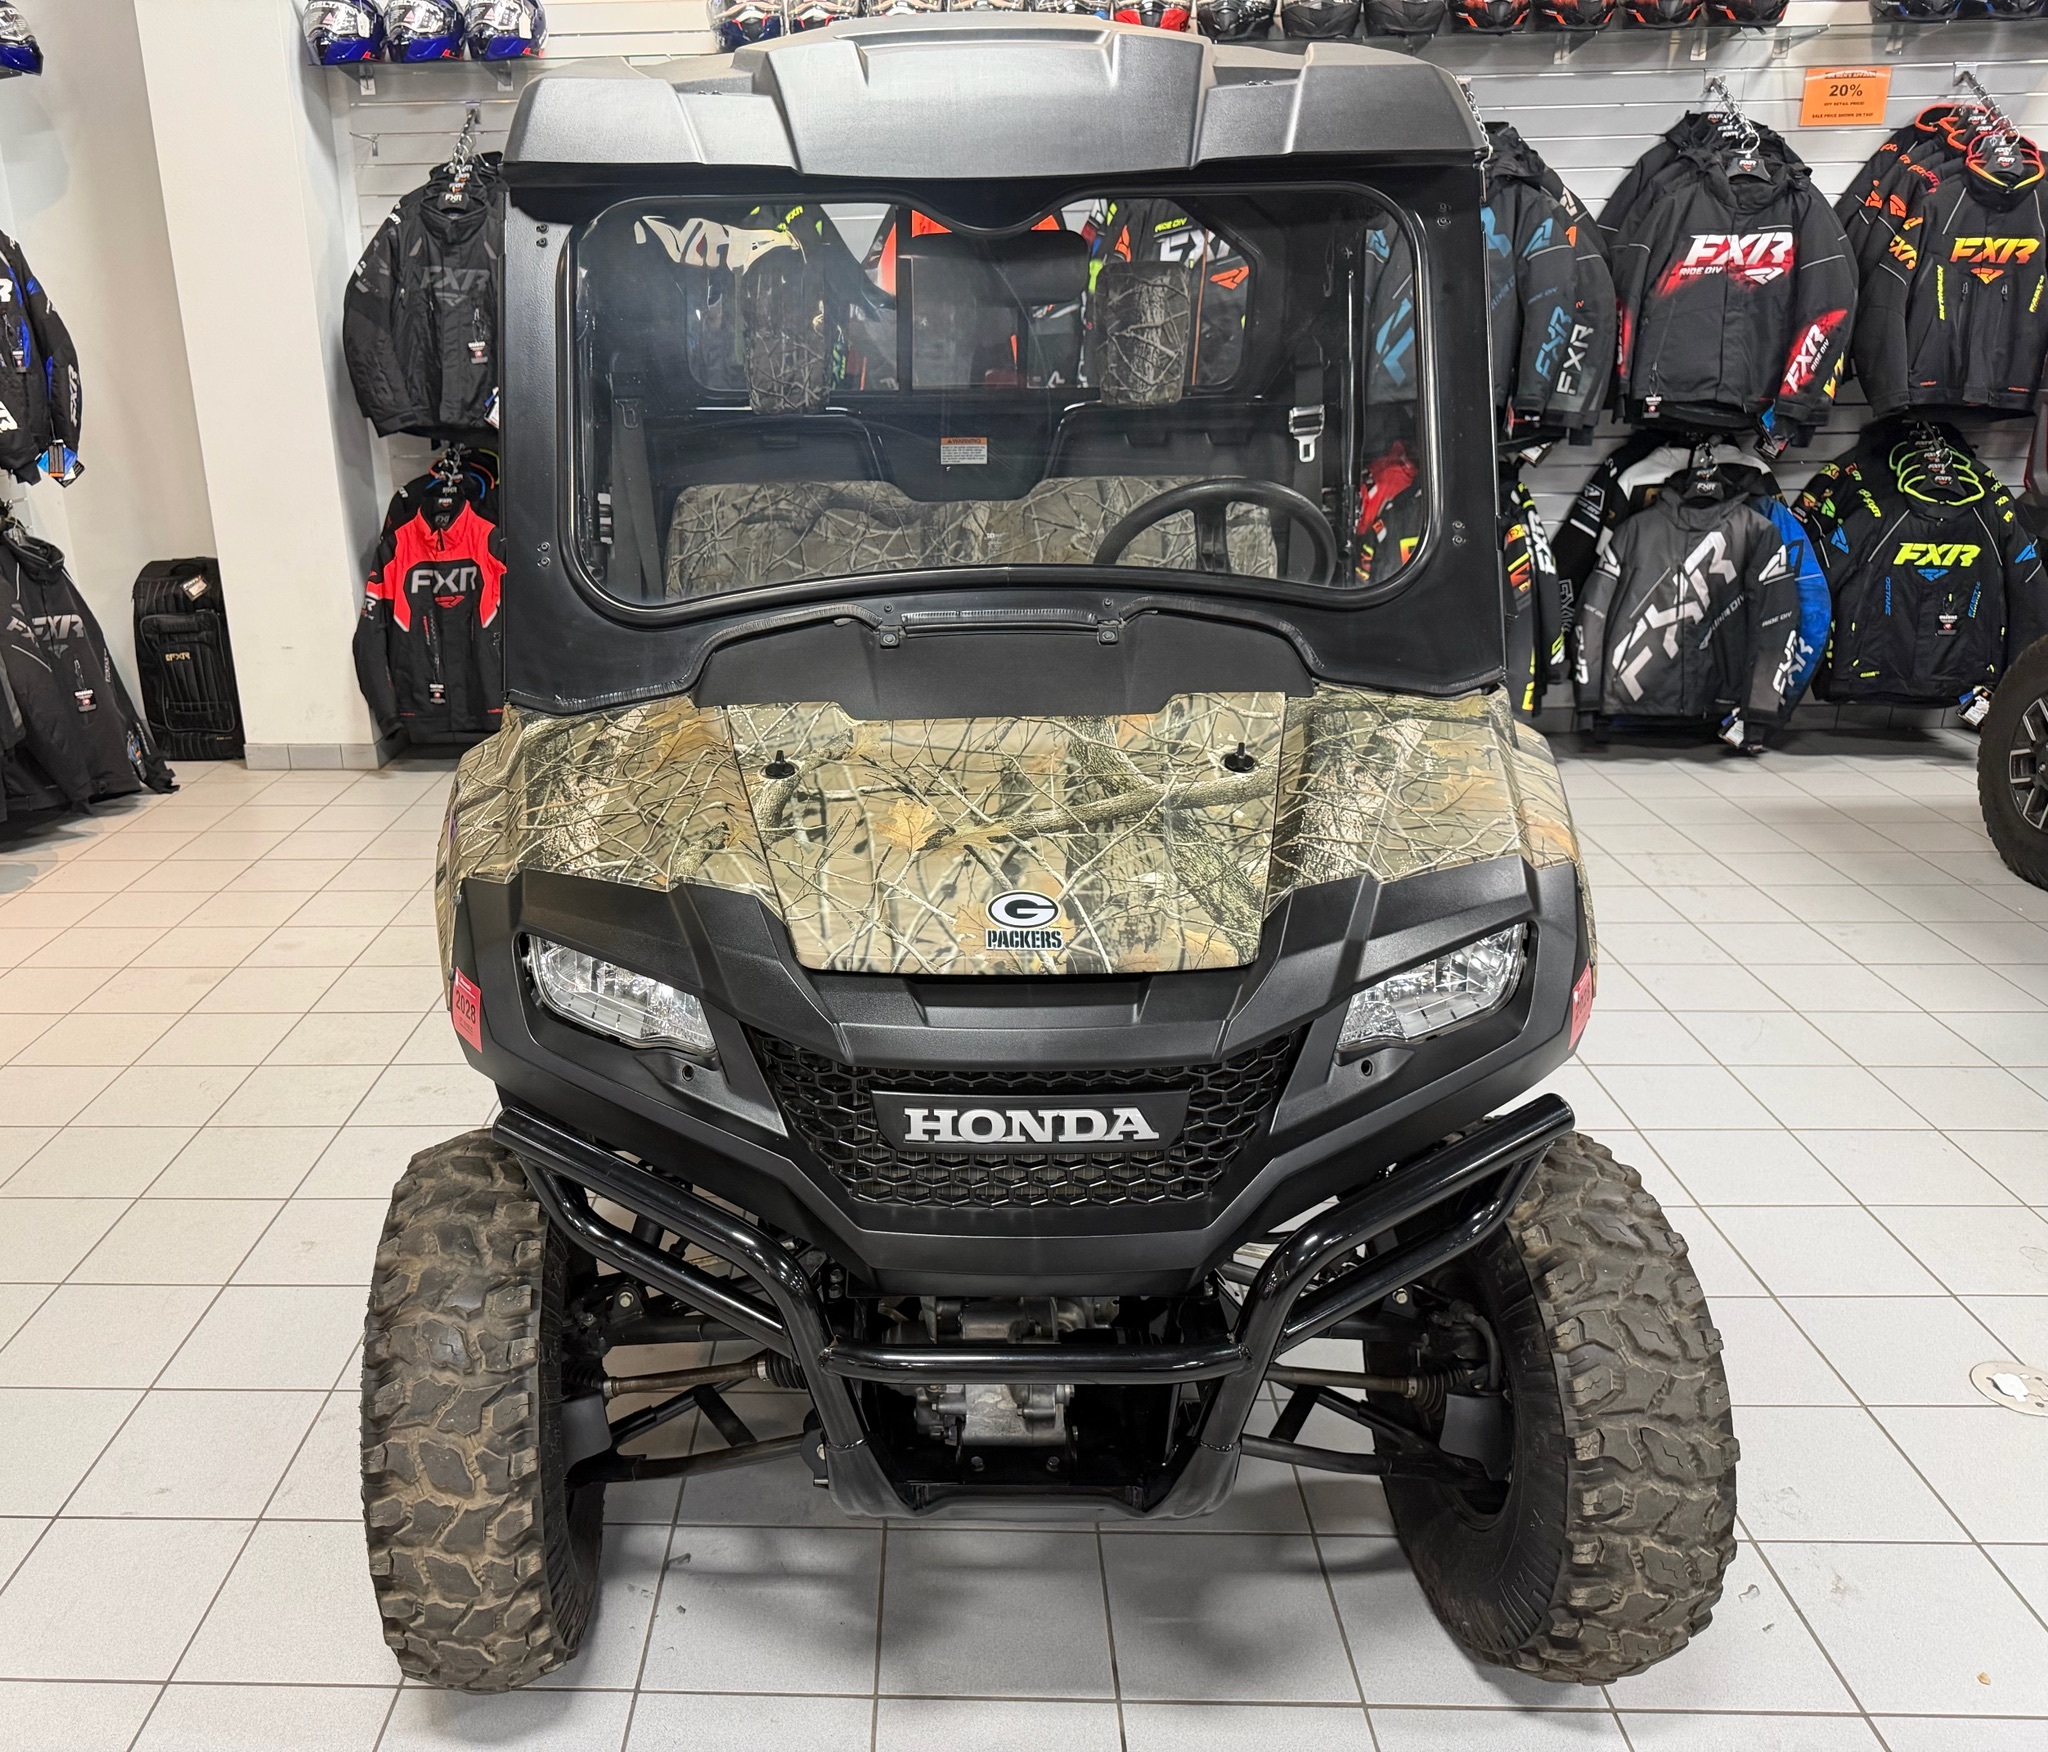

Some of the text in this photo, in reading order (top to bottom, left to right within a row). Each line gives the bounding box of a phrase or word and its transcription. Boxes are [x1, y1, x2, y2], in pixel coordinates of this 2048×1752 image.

[1829, 84, 1863, 97] 20%
[1683, 232, 1794, 267] FXR
[1950, 237, 2040, 264] FXR
[420, 265, 491, 292] FXR
[1680, 266, 1723, 276] RIDE DIV
[1556, 323, 1595, 396] FXR
[1784, 324, 1826, 394] FXR
[1893, 542, 1982, 567] FXR
[411, 566, 478, 594] FXR
[6, 615, 40, 648] FX
[32, 613, 86, 642] FXR
[1612, 531, 1738, 702] FXR
[988, 892, 1059, 928] G
[987, 930, 1063, 949] PACKERS
[455, 989, 477, 1025] 2028
[903, 1107, 1160, 1143] HONDA
